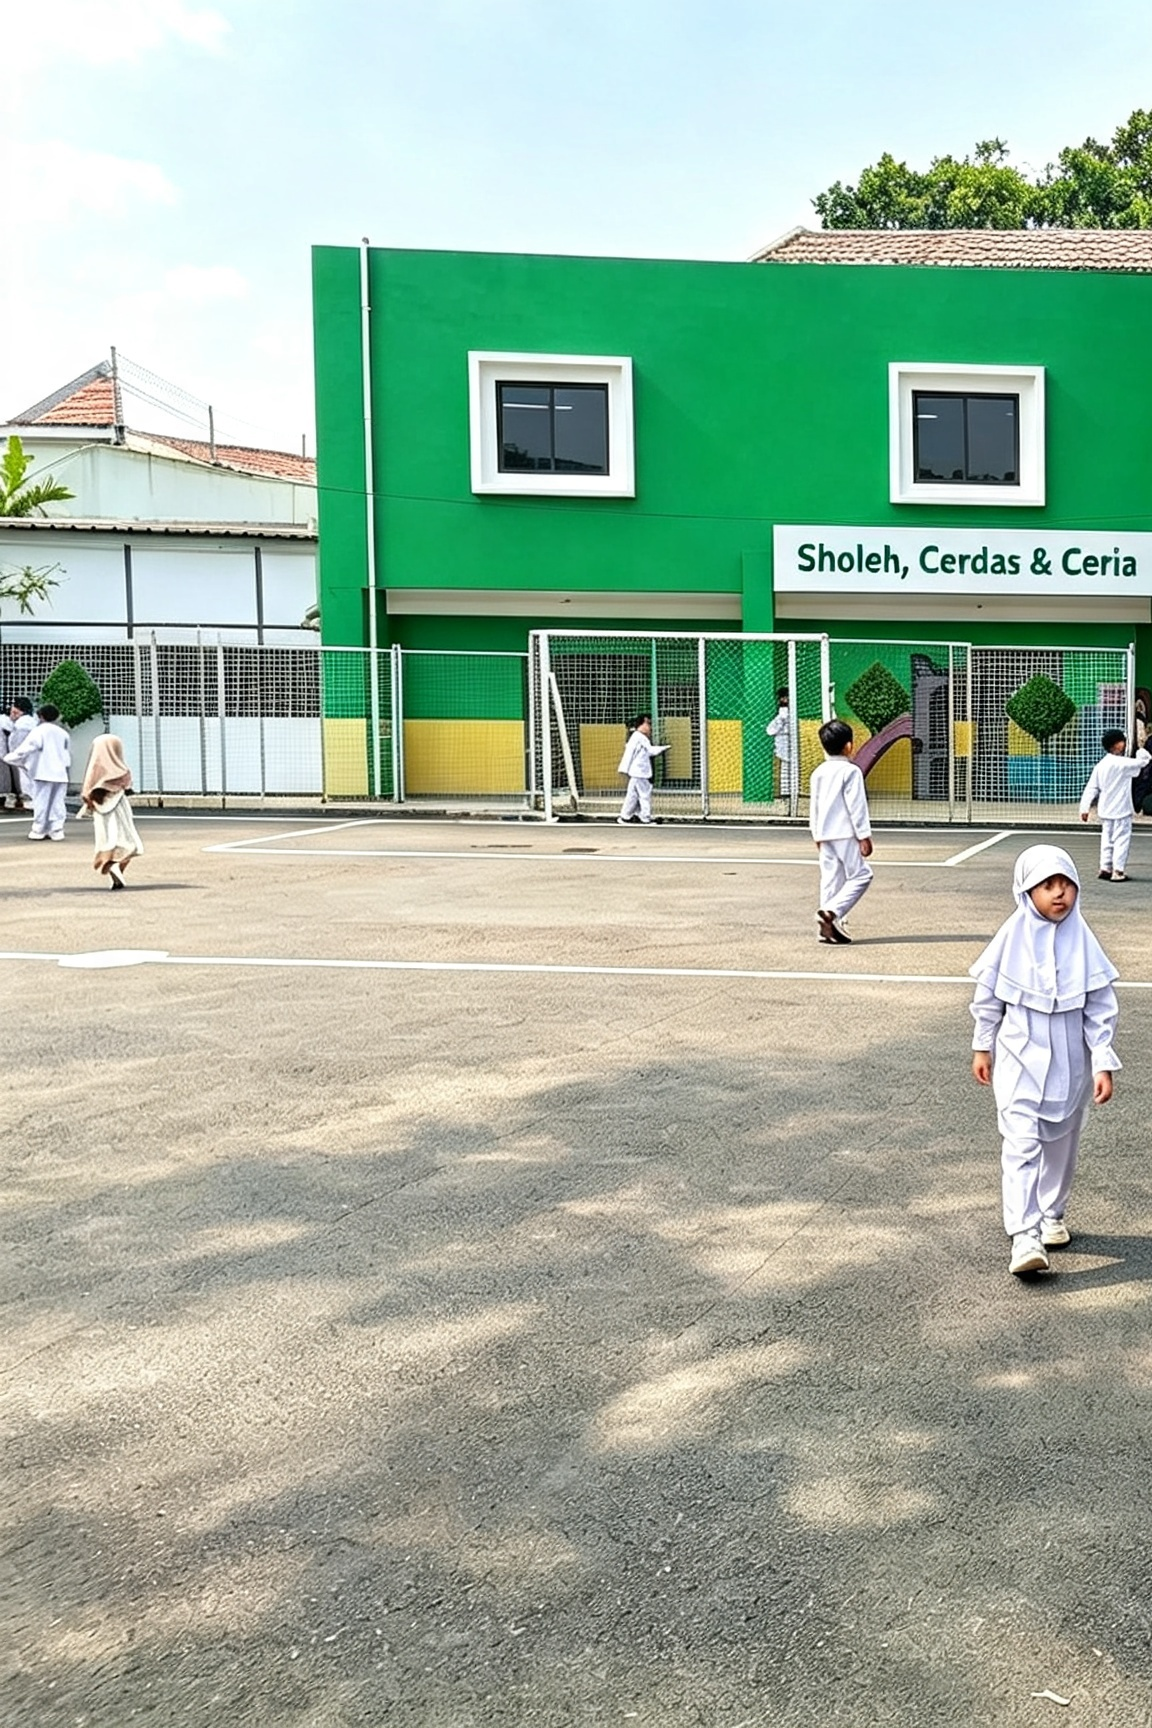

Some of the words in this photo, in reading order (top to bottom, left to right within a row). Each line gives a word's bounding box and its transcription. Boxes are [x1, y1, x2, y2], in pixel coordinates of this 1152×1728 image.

[797, 543, 909, 580] Sholeh,
[918, 544, 1021, 576] Cerdas
[1029, 547, 1053, 576] &
[1061, 547, 1137, 577] Ceria
